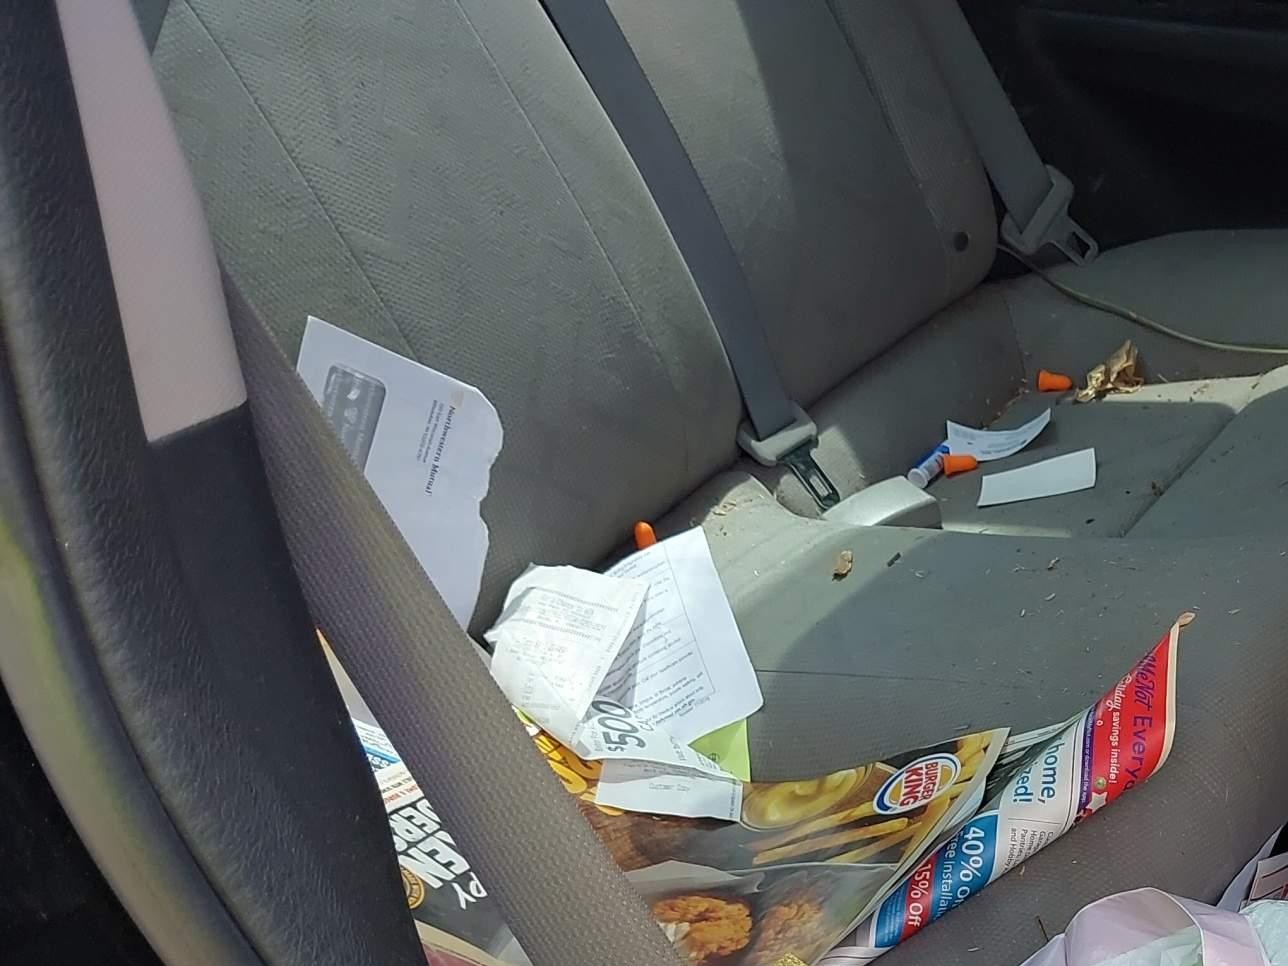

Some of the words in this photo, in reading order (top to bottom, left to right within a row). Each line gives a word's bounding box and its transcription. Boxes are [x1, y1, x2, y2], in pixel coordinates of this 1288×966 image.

[434, 406, 456, 461] Northwestern
[425, 464, 440, 495] Mutual
[592, 699, 646, 752] $500
[1110, 712, 1119, 746] savings
[919, 762, 938, 801] BURGER
[1038, 743, 1064, 804] home,
[1108, 748, 1120, 783] inside!
[900, 766, 923, 806] KING
[1008, 827, 1019, 842] and
[959, 826, 984, 881] 40%
[1005, 843, 1016, 866] Hobby
[453, 873, 488, 910] PY
[911, 863, 932, 898] 15%
[904, 901, 926, 930] Off
